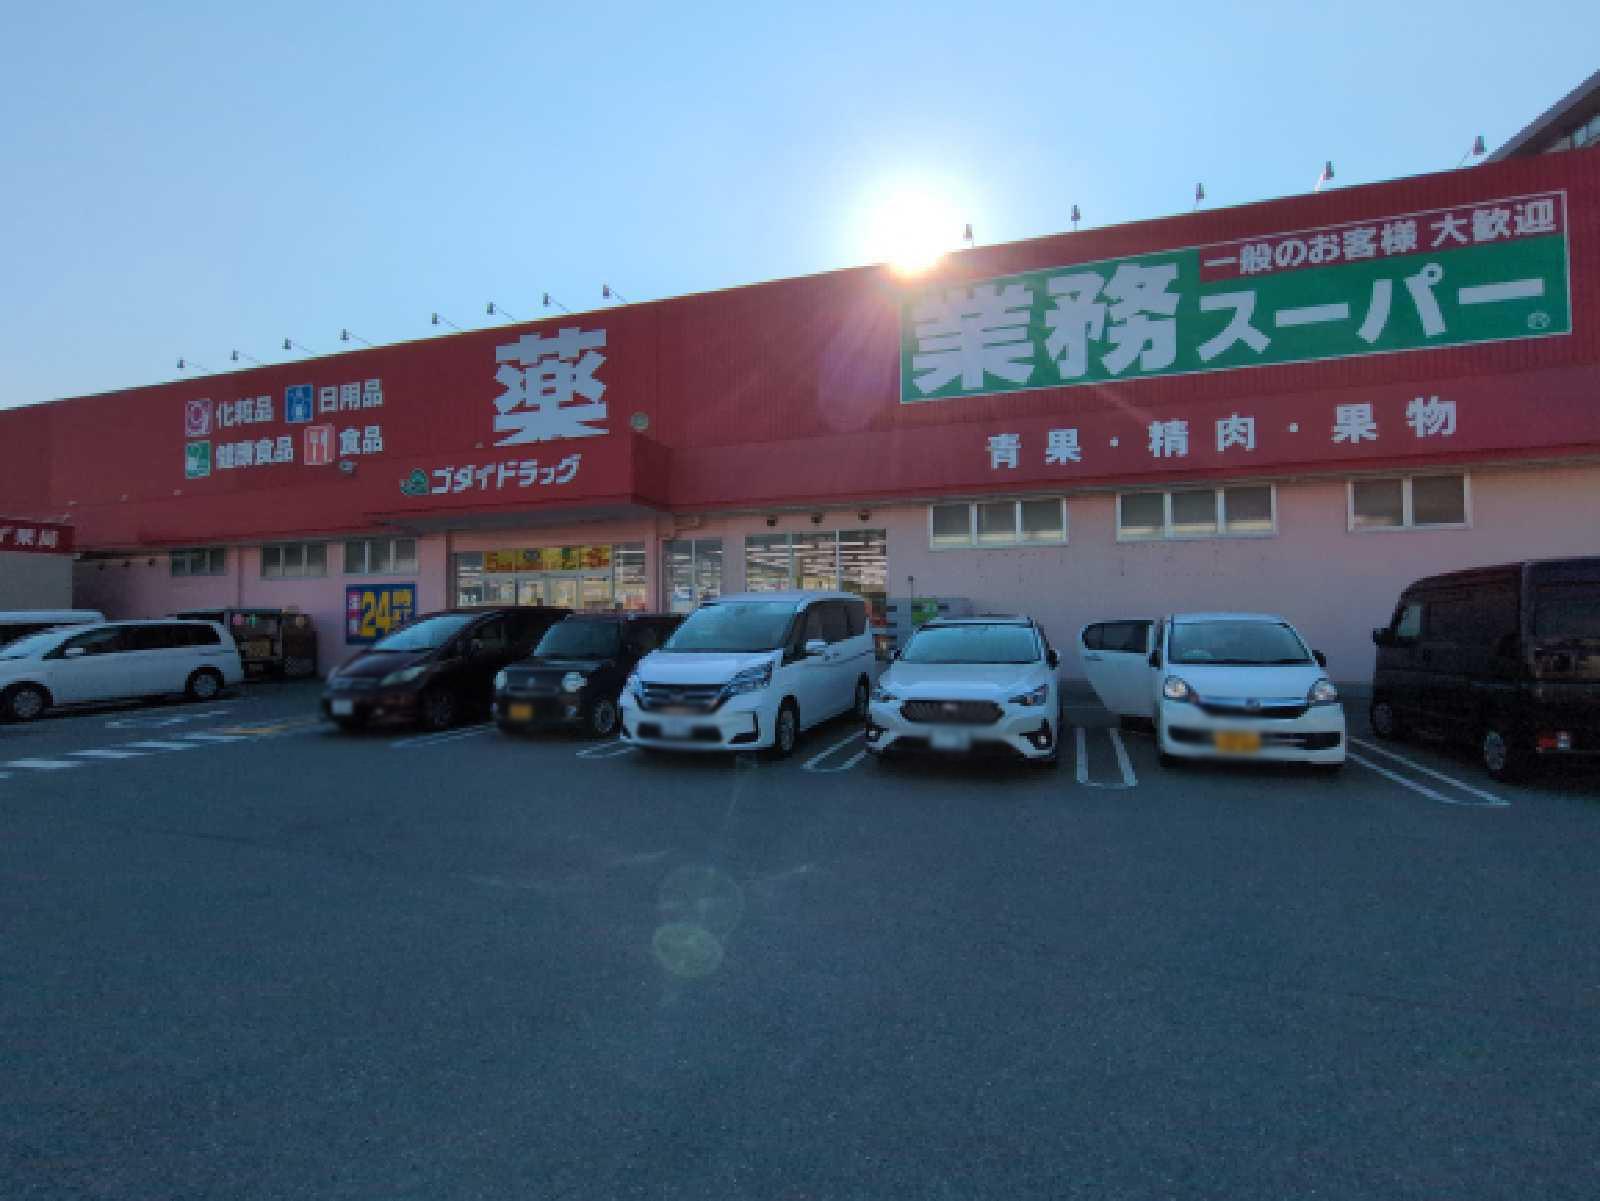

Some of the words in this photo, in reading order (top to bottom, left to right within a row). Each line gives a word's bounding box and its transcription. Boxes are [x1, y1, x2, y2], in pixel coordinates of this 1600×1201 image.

[1204, 220, 1418, 275] 一般のお客様
[1430, 198, 1557, 247] 大歓迎
[910, 262, 1545, 395] 業務スーパー
[319, 378, 384, 413] 日用品
[492, 328, 610, 447] 薬
[216, 395, 274, 429] 化粧品
[339, 425, 384, 456] 食品
[431, 453, 582, 494] ゴダイドラッグ
